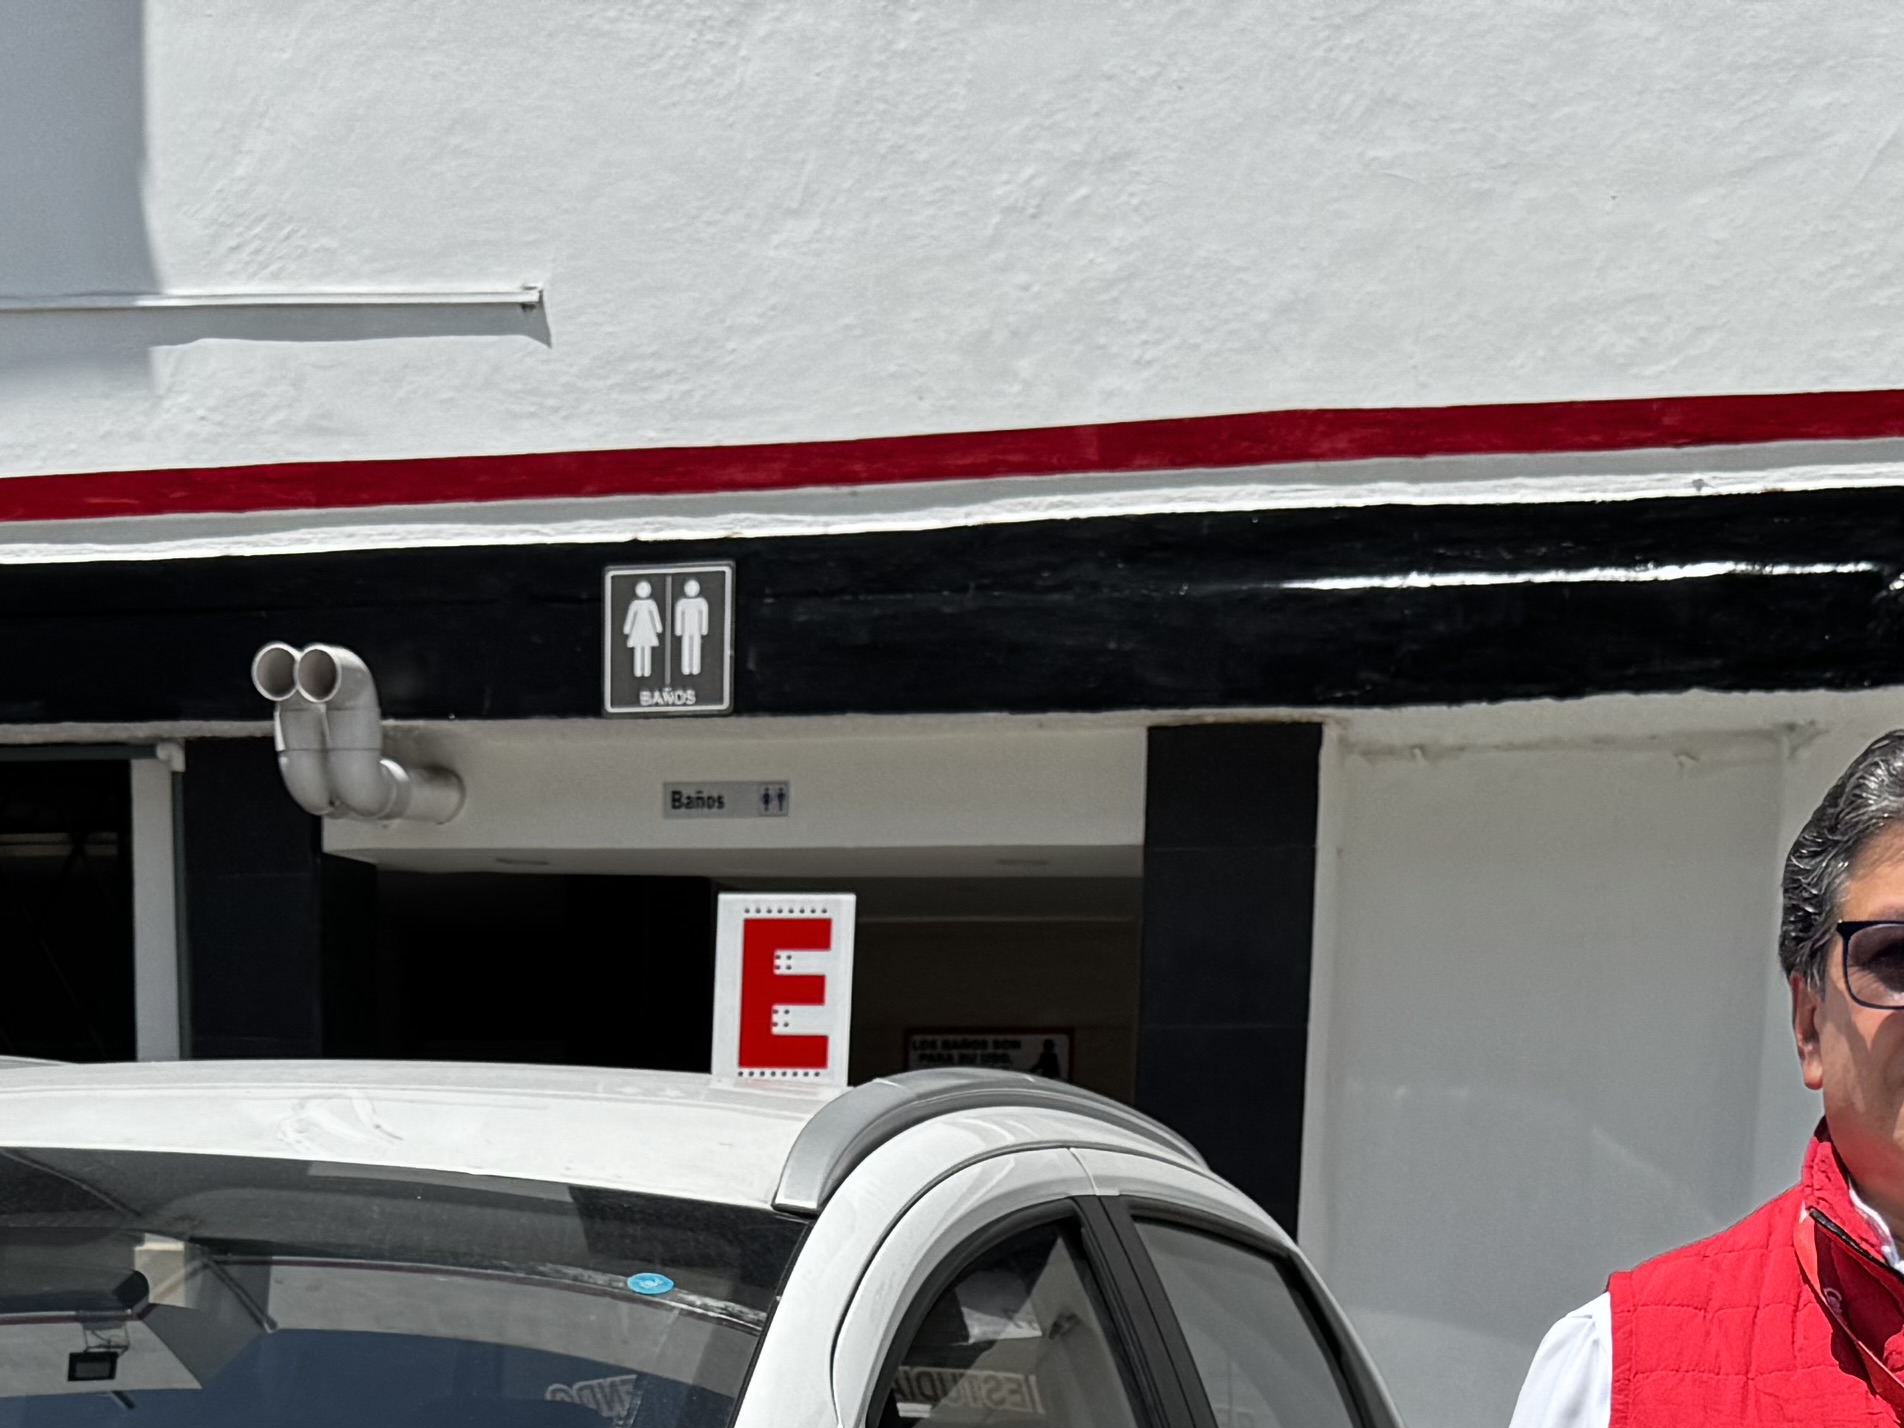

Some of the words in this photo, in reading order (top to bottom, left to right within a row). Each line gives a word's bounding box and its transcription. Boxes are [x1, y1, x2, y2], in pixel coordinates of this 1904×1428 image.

[639, 687, 697, 706] BAÑOS
[671, 789, 726, 810] Baños
[738, 918, 832, 1069] E
